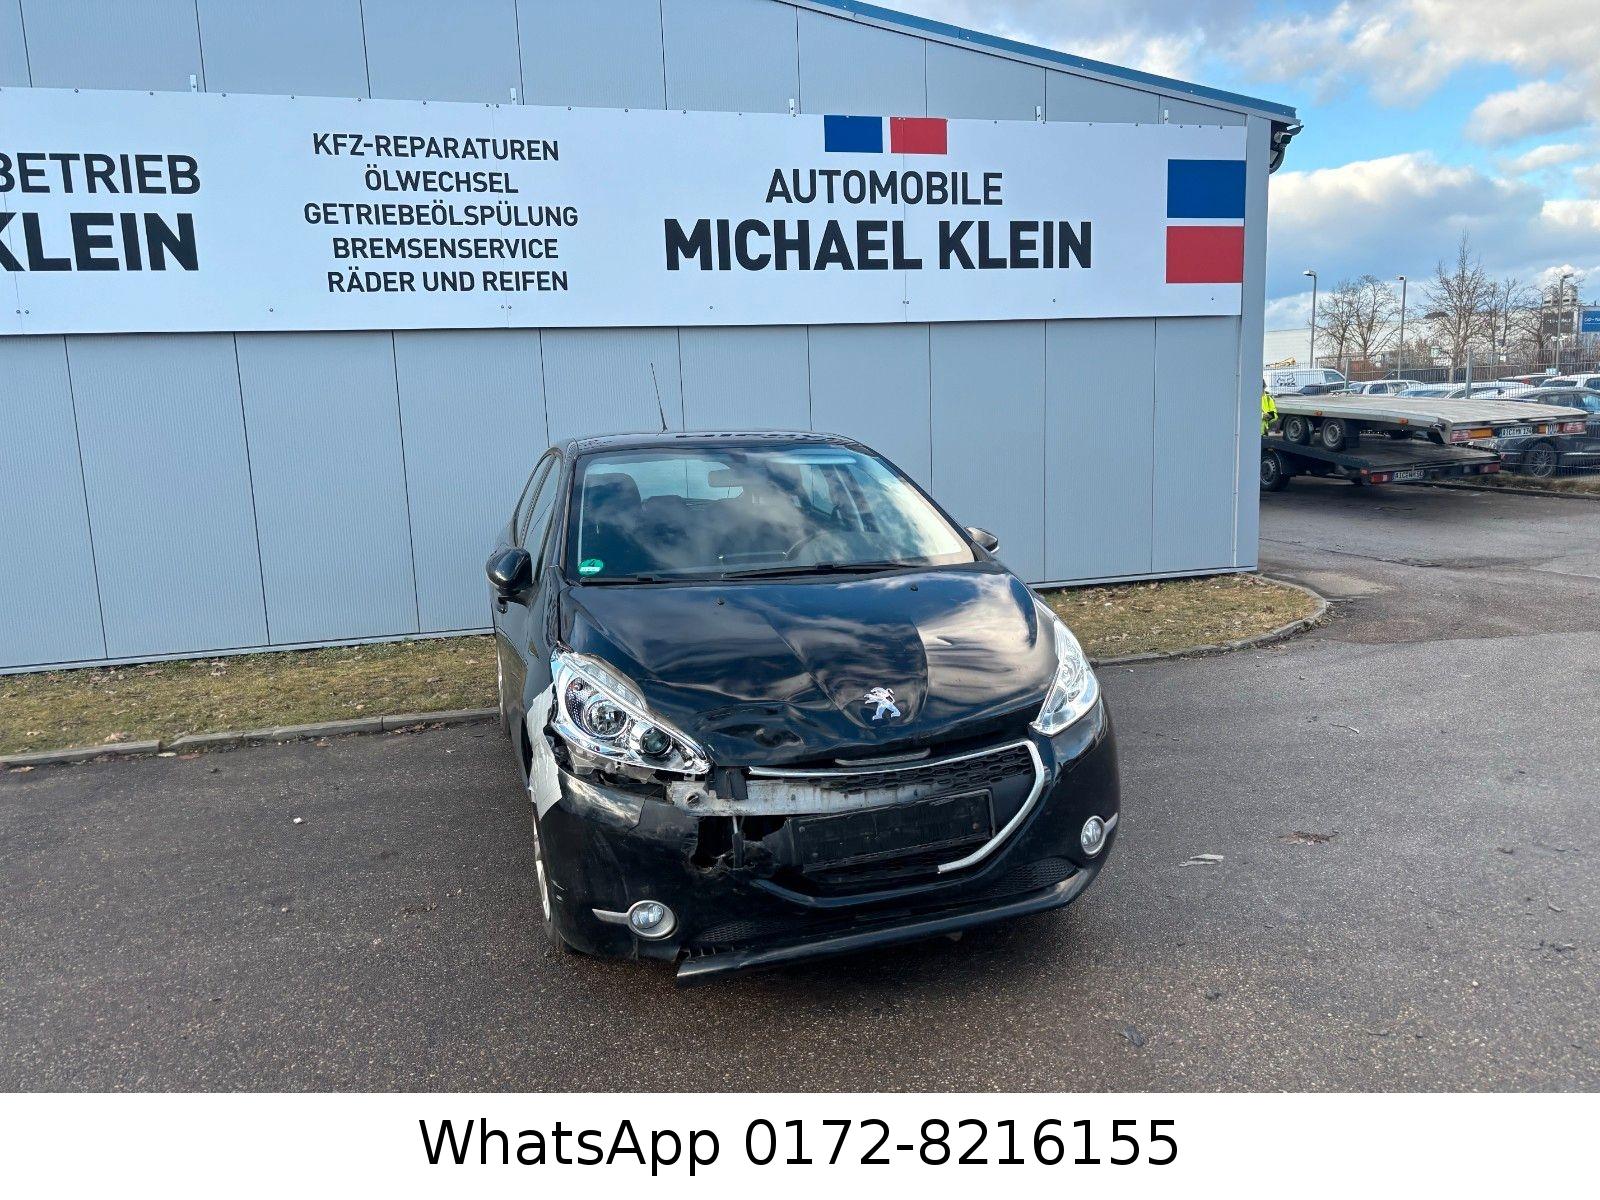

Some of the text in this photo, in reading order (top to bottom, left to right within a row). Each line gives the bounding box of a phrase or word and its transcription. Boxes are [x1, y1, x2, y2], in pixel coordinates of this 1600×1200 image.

[312, 132, 559, 162] KFZ-REPARATUREN
[364, 163, 519, 194] ÖLWECHSEL
[765, 168, 1003, 206] AUTOMOBILE
[303, 199, 579, 227] GETRIEBEÖLSPÜLUNG
[332, 237, 559, 259] BREMSENSERVICE
[663, 218, 1092, 272] MICHAEL KLEIN
[327, 265, 568, 293] RÄDER UND REIFEN
